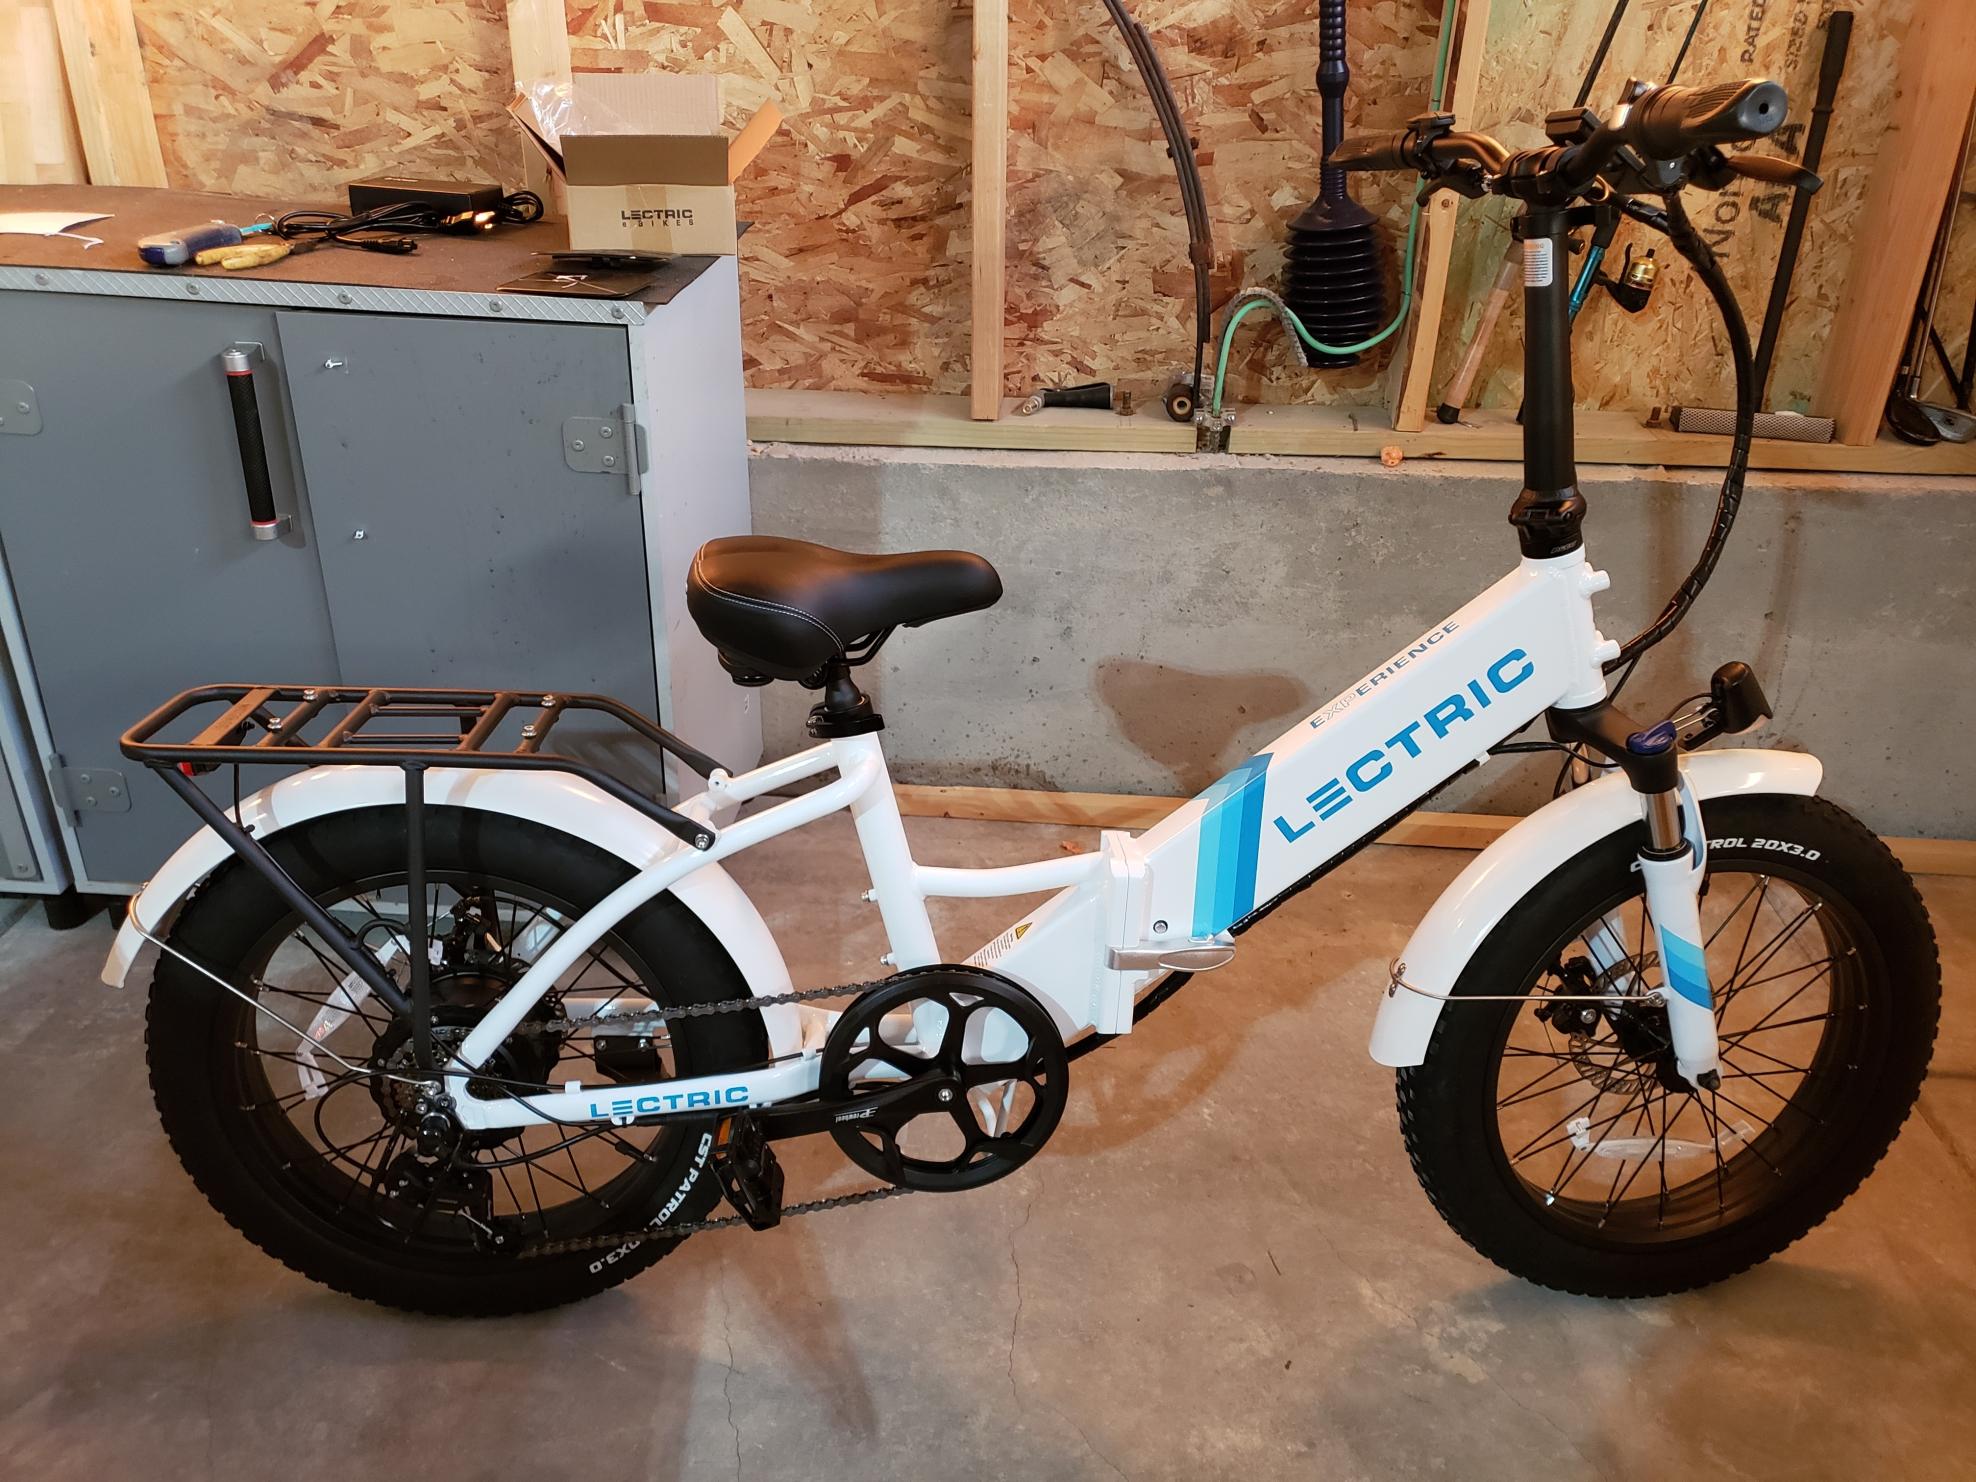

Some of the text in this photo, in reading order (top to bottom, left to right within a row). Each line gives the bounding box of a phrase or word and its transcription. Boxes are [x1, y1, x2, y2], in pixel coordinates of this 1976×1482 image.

[621, 209, 693, 220] LECTRIC
[1310, 621, 1460, 729] EXPERIENCE
[1273, 648, 1534, 844] LECTRIC
[1751, 837, 1821, 861] 20X3.0
[590, 1086, 748, 1118] LECTRIC
[695, 1132, 713, 1169] CST
[649, 1167, 700, 1227] PATROL
